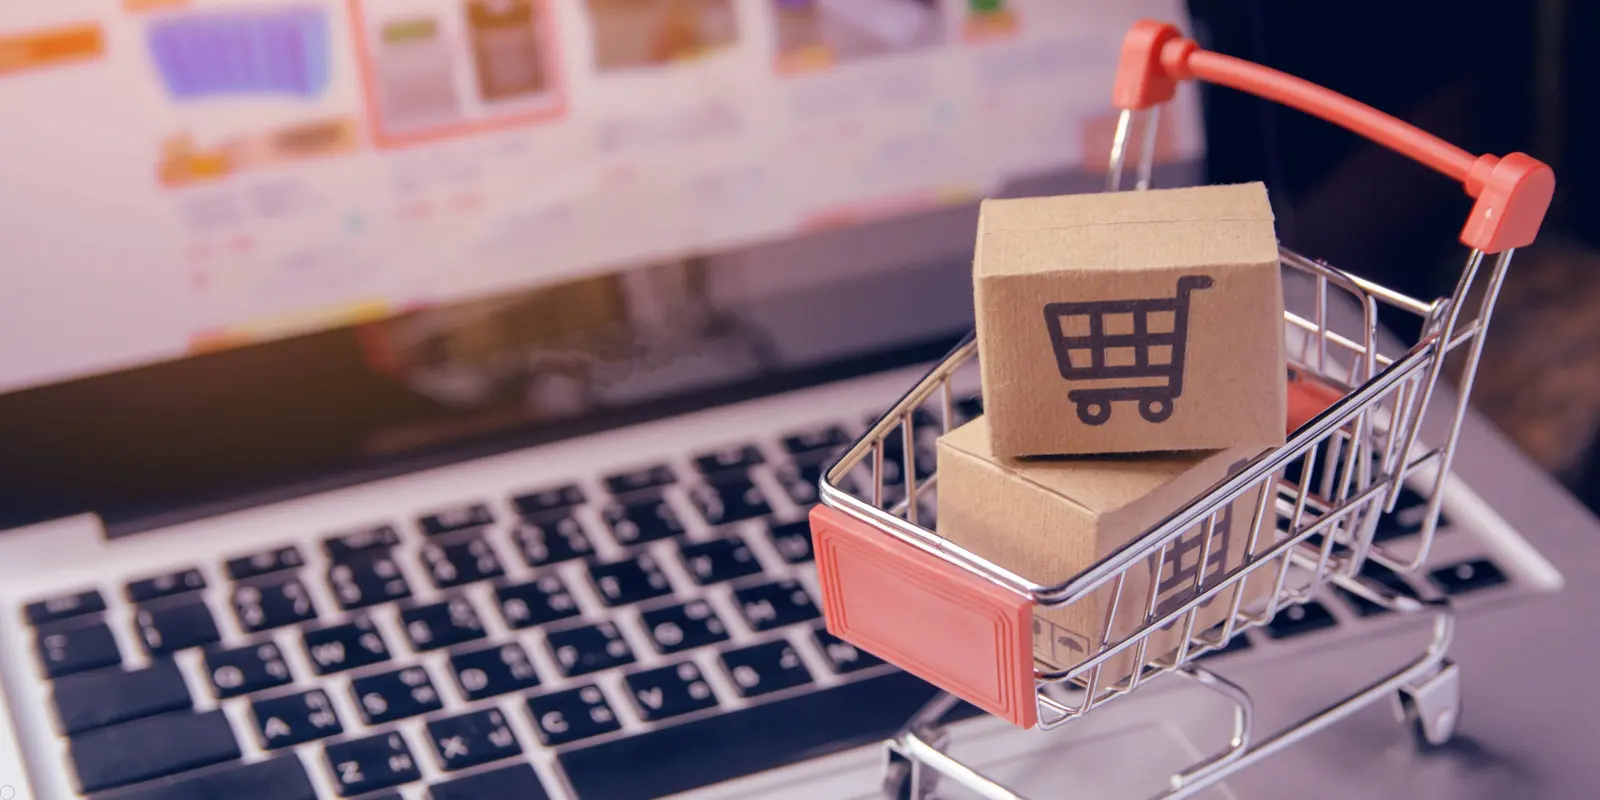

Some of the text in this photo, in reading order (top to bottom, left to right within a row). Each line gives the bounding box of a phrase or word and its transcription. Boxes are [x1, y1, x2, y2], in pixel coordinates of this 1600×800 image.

[312, 642, 344, 665] W
[639, 688, 662, 709] V
[265, 717, 289, 738] A
[542, 712, 567, 733] C
[441, 736, 467, 758] X
[338, 761, 363, 783] Z
